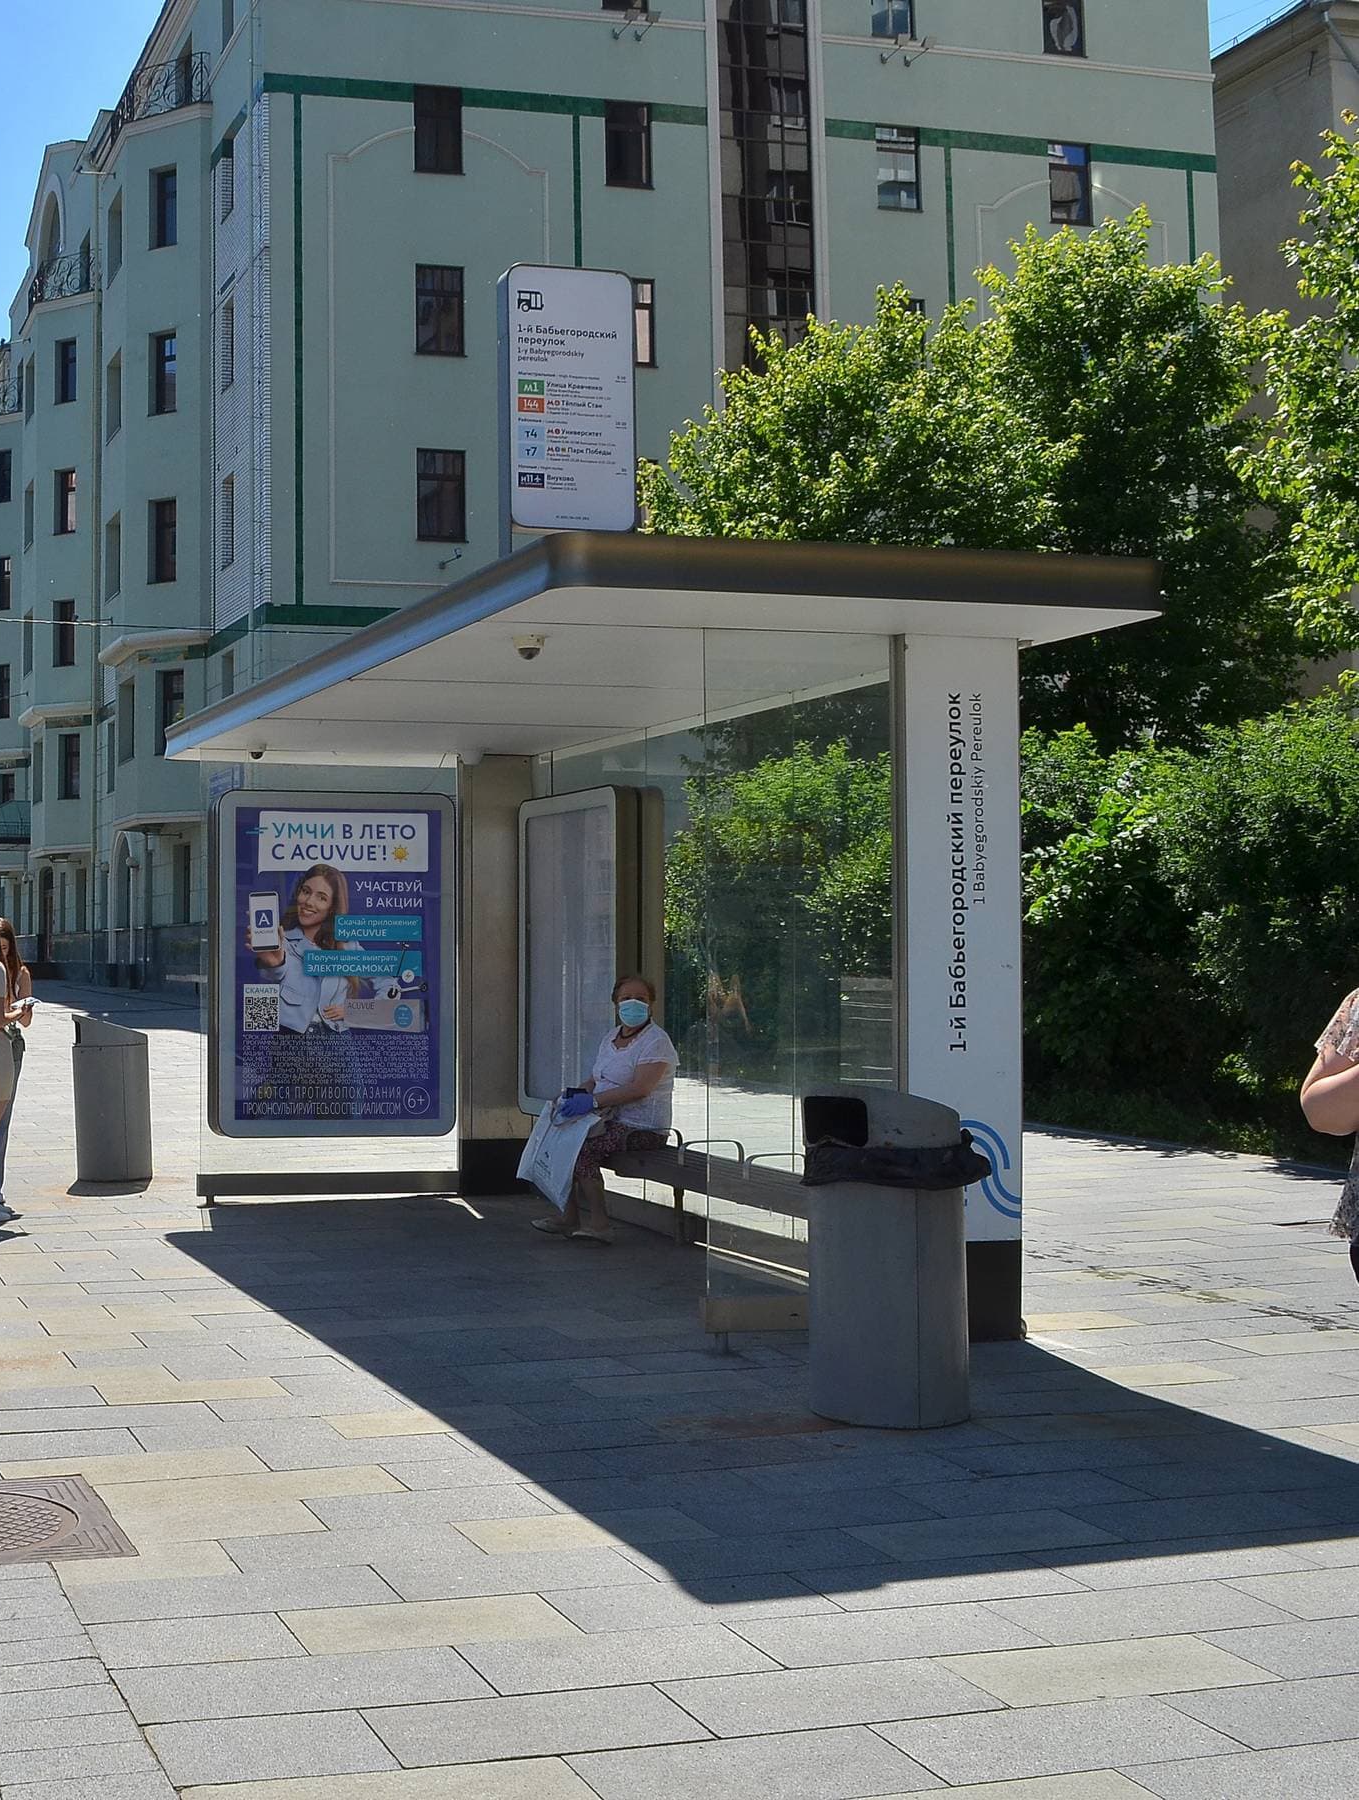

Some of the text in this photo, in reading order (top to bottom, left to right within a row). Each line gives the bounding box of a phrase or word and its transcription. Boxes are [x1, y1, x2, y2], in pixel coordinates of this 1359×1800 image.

[518, 324, 617, 340] 1-й Бабьегородский
[517, 336, 566, 347] переулок
[546, 381, 566, 390] Улица
[523, 399, 539, 408] 144
[561, 428, 602, 438] Университет
[567, 447, 584, 455] Парк
[586, 448, 612, 456] Победы
[546, 474, 575, 482] Внуково
[968, 692, 983, 762] Pereulok
[272, 822, 416, 840] УМЧИ В ЛЕТО
[970, 764, 987, 892] Babyegorodskiy
[272, 843, 285, 860] С
[945, 692, 968, 1052] 1-й Бабьегородский переулок
[355, 879, 423, 893] УЧАСТВУЙ
[366, 897, 423, 909] В АКЦИИ
[338, 917, 366, 926] Скачай
[338, 929, 387, 938] MyACUVUE
[307, 953, 339, 962] Получи
[307, 964, 395, 973] ЭЛЕКТРОСАМОКАТ
[347, 1001, 375, 1010] ACUVUE
[242, 1086, 401, 1099] ИМЕЮТСЯ ПРОТИВОПОКАЗАНИЯ
[408, 1093, 425, 1109] 6+
[242, 1100, 401, 1115] ПРОКОНСУЛЬТИРУЙТЕСЬ СО СПЕЦИАЛИСТОМ
